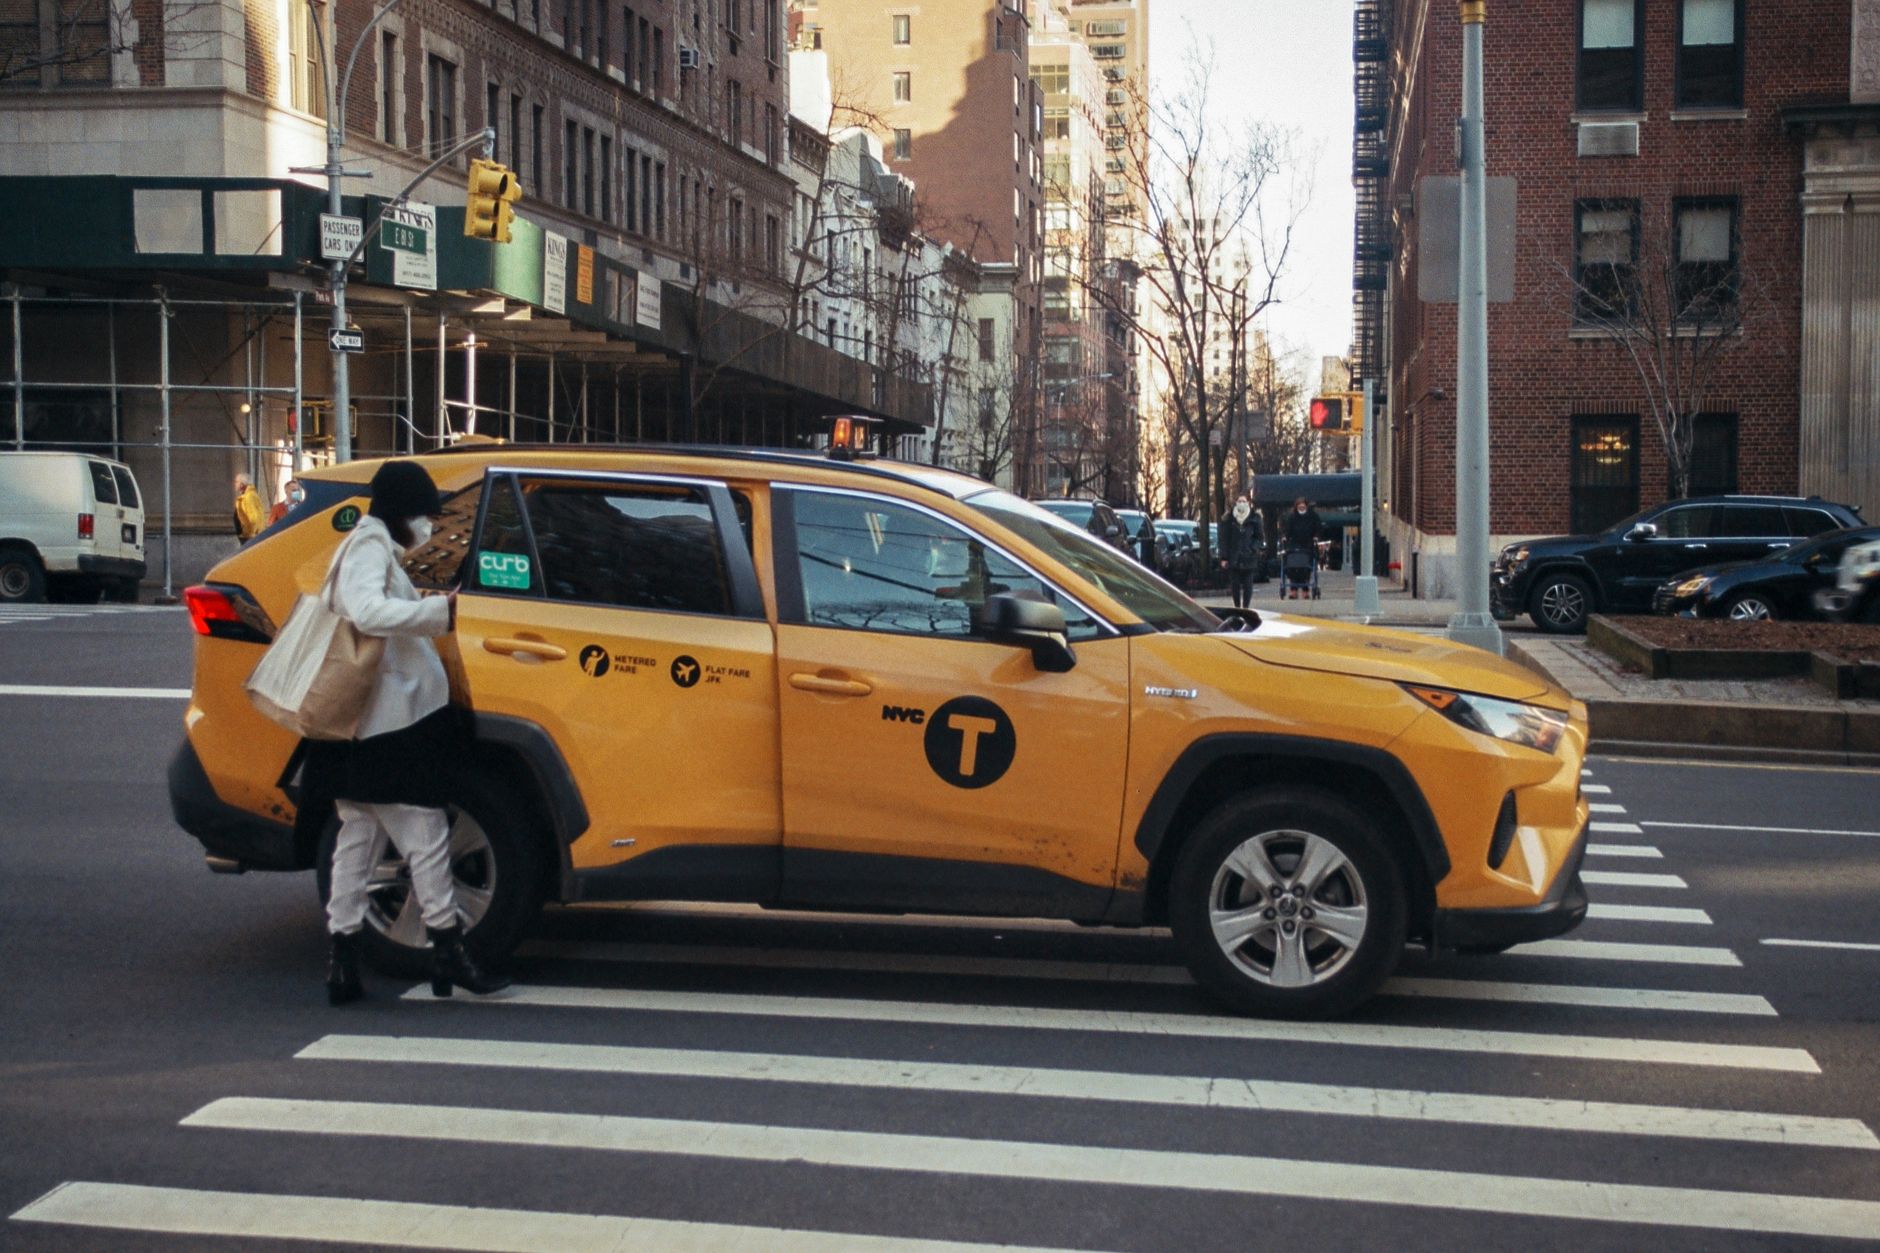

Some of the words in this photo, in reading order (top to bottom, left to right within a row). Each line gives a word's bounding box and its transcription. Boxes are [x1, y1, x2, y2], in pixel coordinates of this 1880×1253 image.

[323, 220, 360, 236] PASSENGER
[324, 236, 341, 251] CARS
[395, 227, 400, 245] E
[547, 237, 565, 260] KINGS
[336, 335, 348, 345] ONE
[348, 336, 359, 345] WAY
[481, 556, 529, 572] curb
[614, 655, 656, 666] METERED
[614, 665, 636, 674] FARE
[705, 665, 727, 675] FLAT
[728, 668, 751, 678] FARE
[705, 676, 721, 684] JFK
[882, 705, 925, 724] NYC
[948, 713, 996, 776] T
